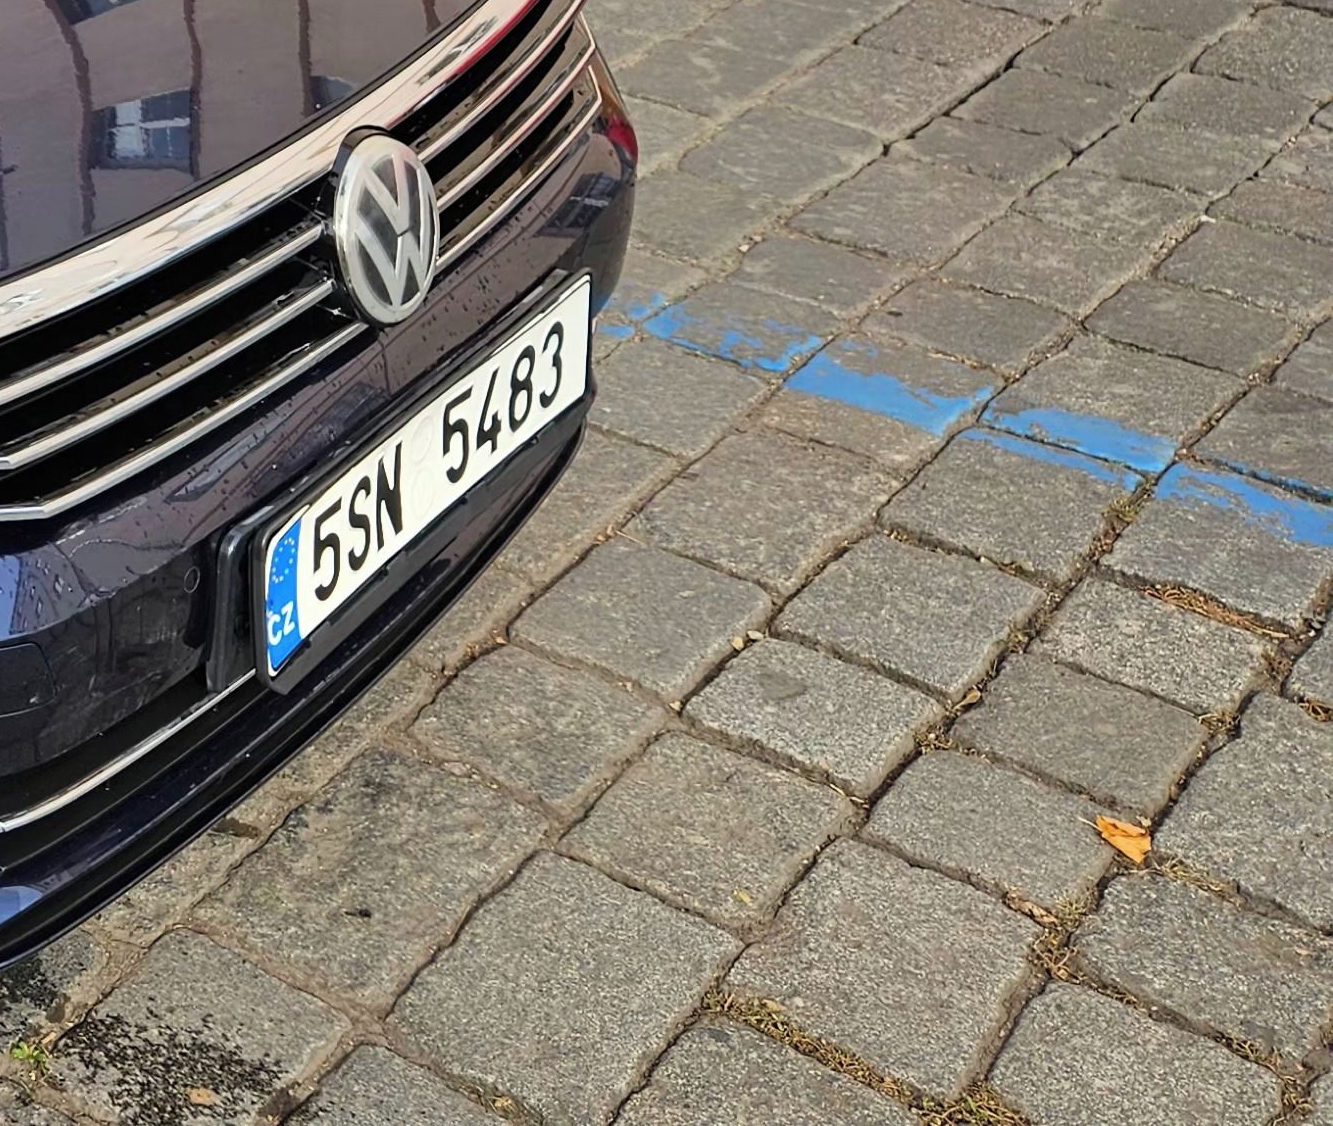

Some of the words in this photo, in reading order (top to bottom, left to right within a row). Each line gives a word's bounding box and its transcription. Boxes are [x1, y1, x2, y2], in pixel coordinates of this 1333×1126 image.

[312, 442, 405, 603] 5SN
[441, 320, 566, 485] 5483
[267, 606, 295, 647] CZ
